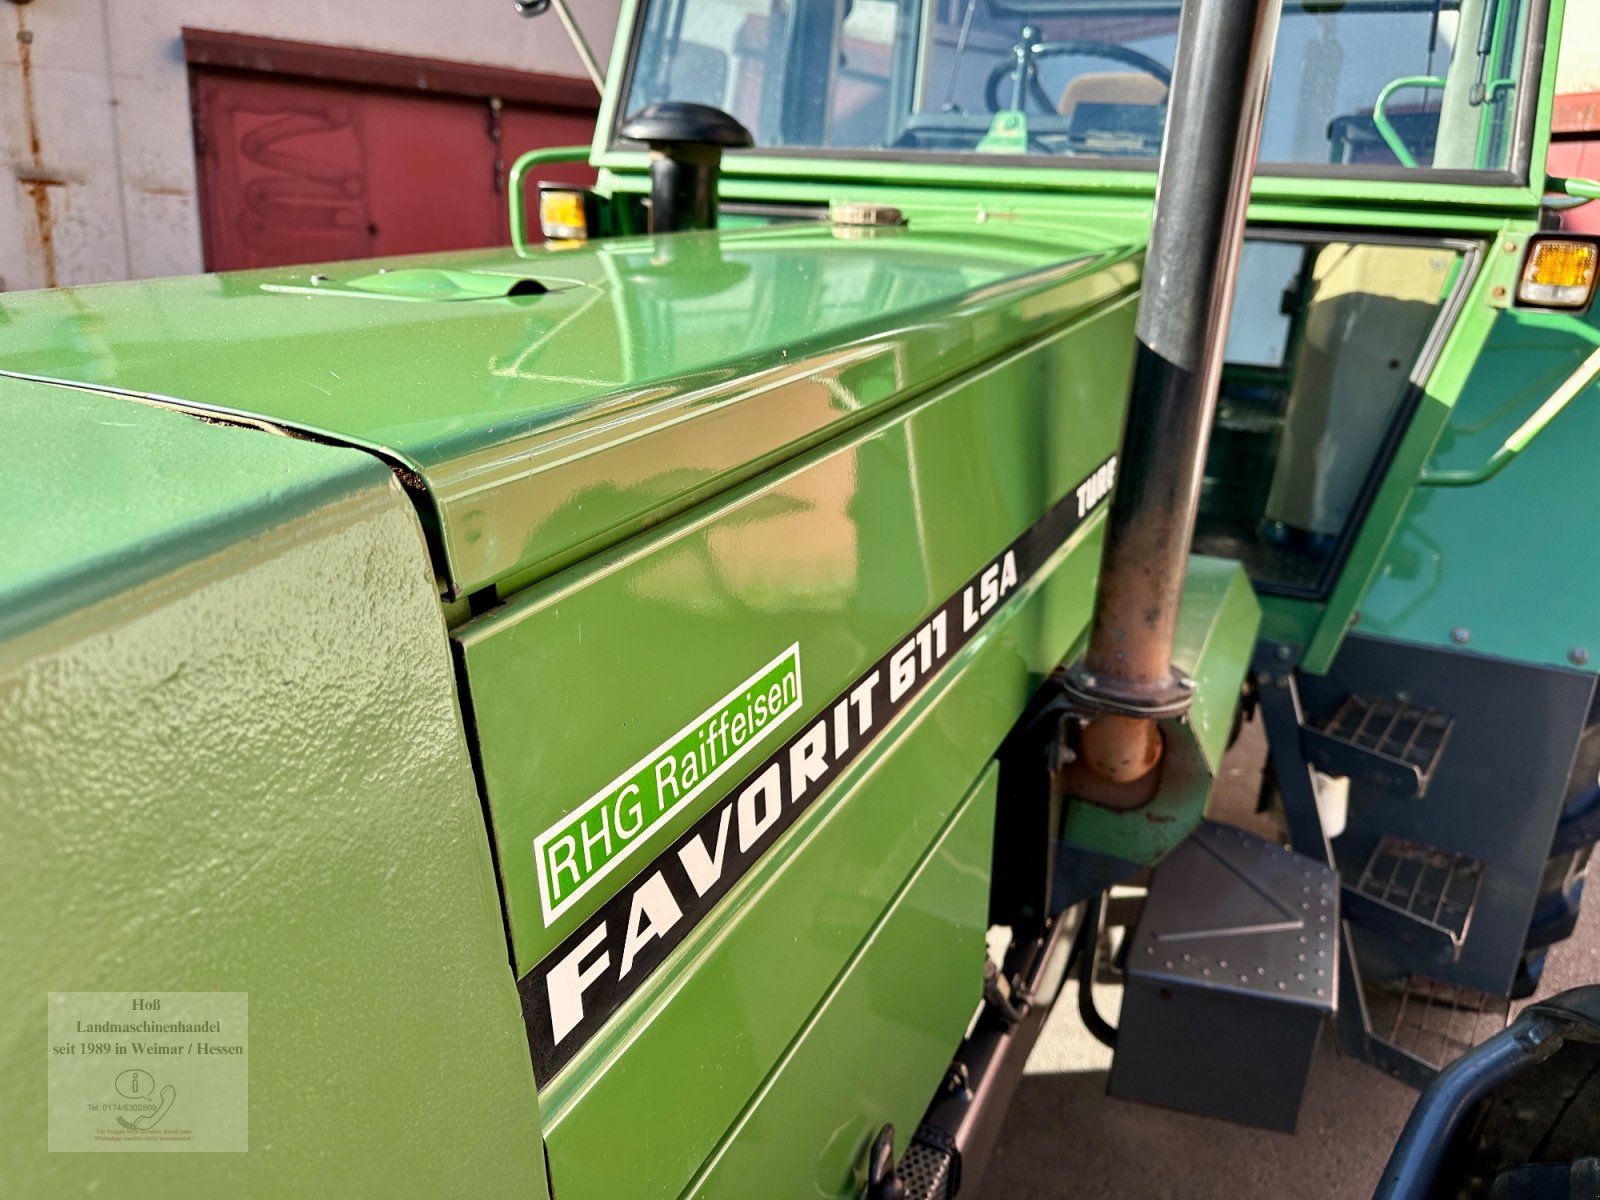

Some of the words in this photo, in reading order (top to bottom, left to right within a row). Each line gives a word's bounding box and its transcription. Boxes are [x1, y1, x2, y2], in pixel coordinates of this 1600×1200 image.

[546, 669, 880, 1046] FAVORIT
[889, 609, 947, 704] 611
[962, 549, 1018, 633] LSA
[548, 784, 643, 900] RHG
[656, 671, 797, 810] Raiffeisen
